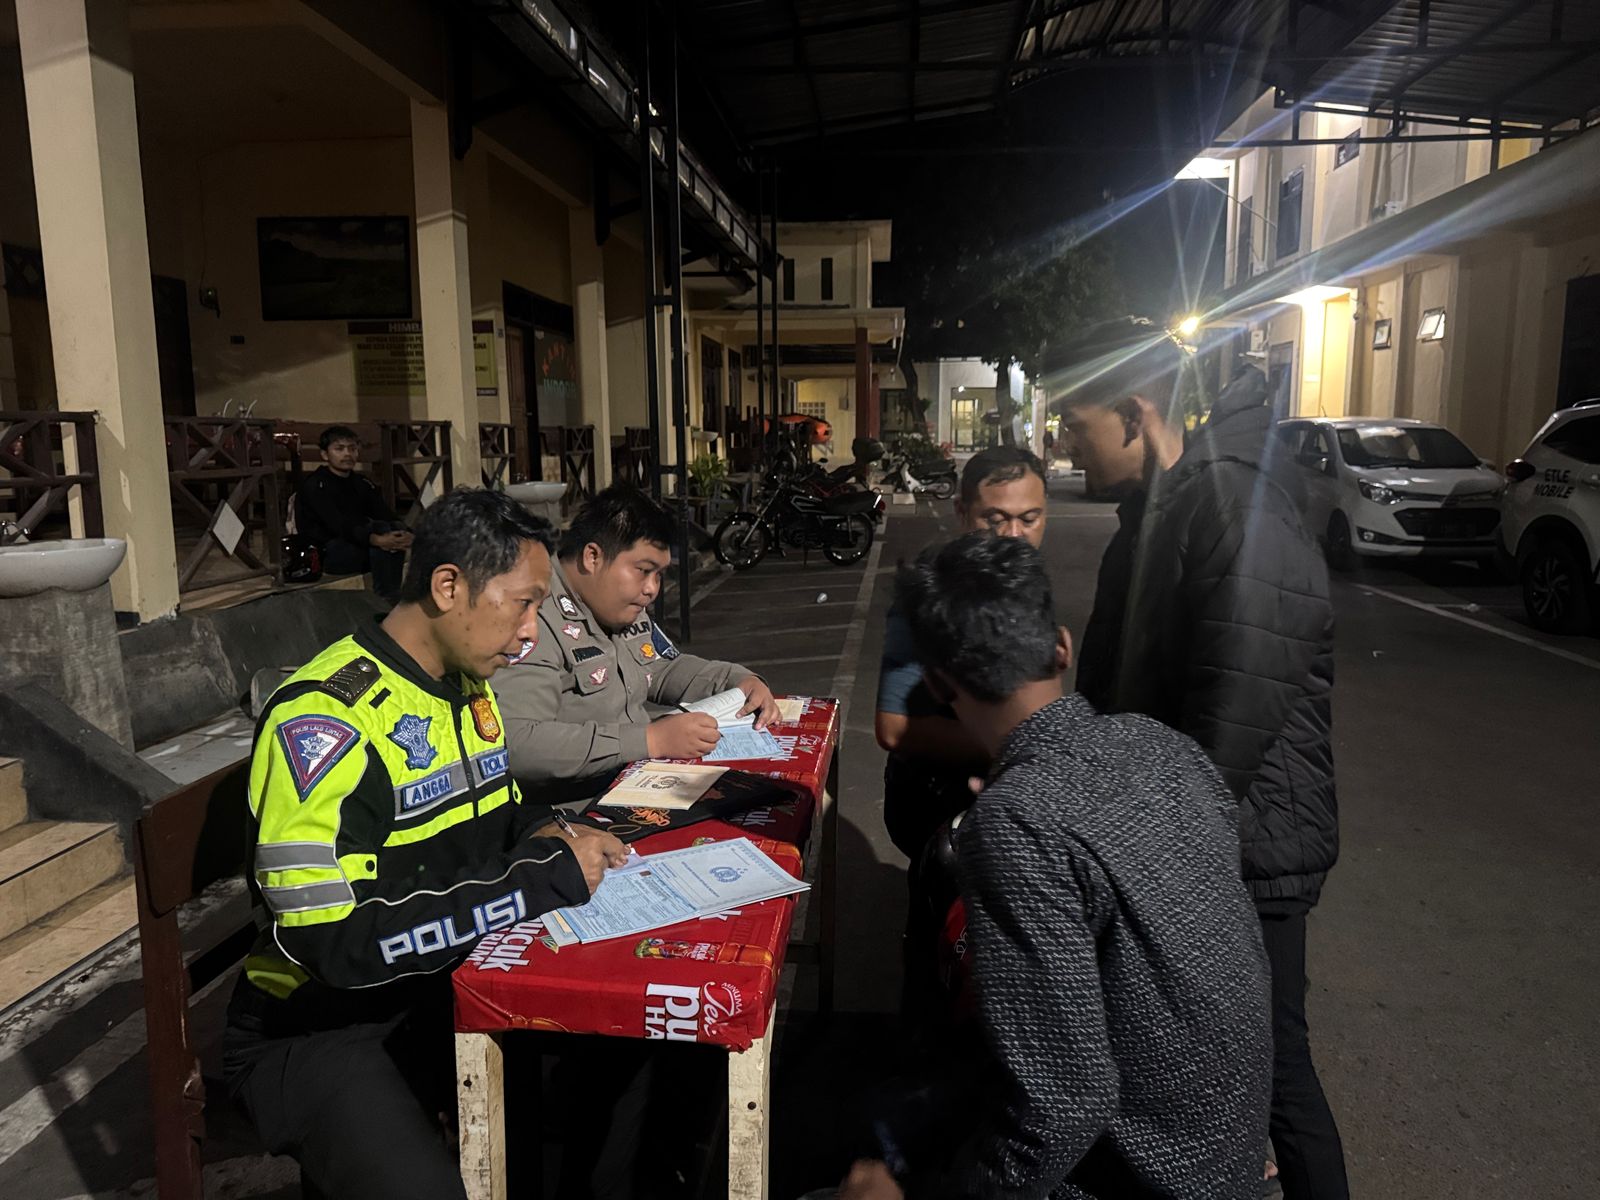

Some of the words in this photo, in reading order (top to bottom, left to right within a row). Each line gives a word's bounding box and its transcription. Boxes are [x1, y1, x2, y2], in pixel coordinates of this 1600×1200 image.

[1545, 469, 1570, 483] ETLE
[1536, 484, 1574, 498] MOBILE
[292, 725, 309, 735] POLISI
[325, 728, 343, 738] LINTAS
[412, 774, 450, 803] ANGGA
[378, 889, 527, 965] POLISI
[478, 917, 545, 973] ucuk
